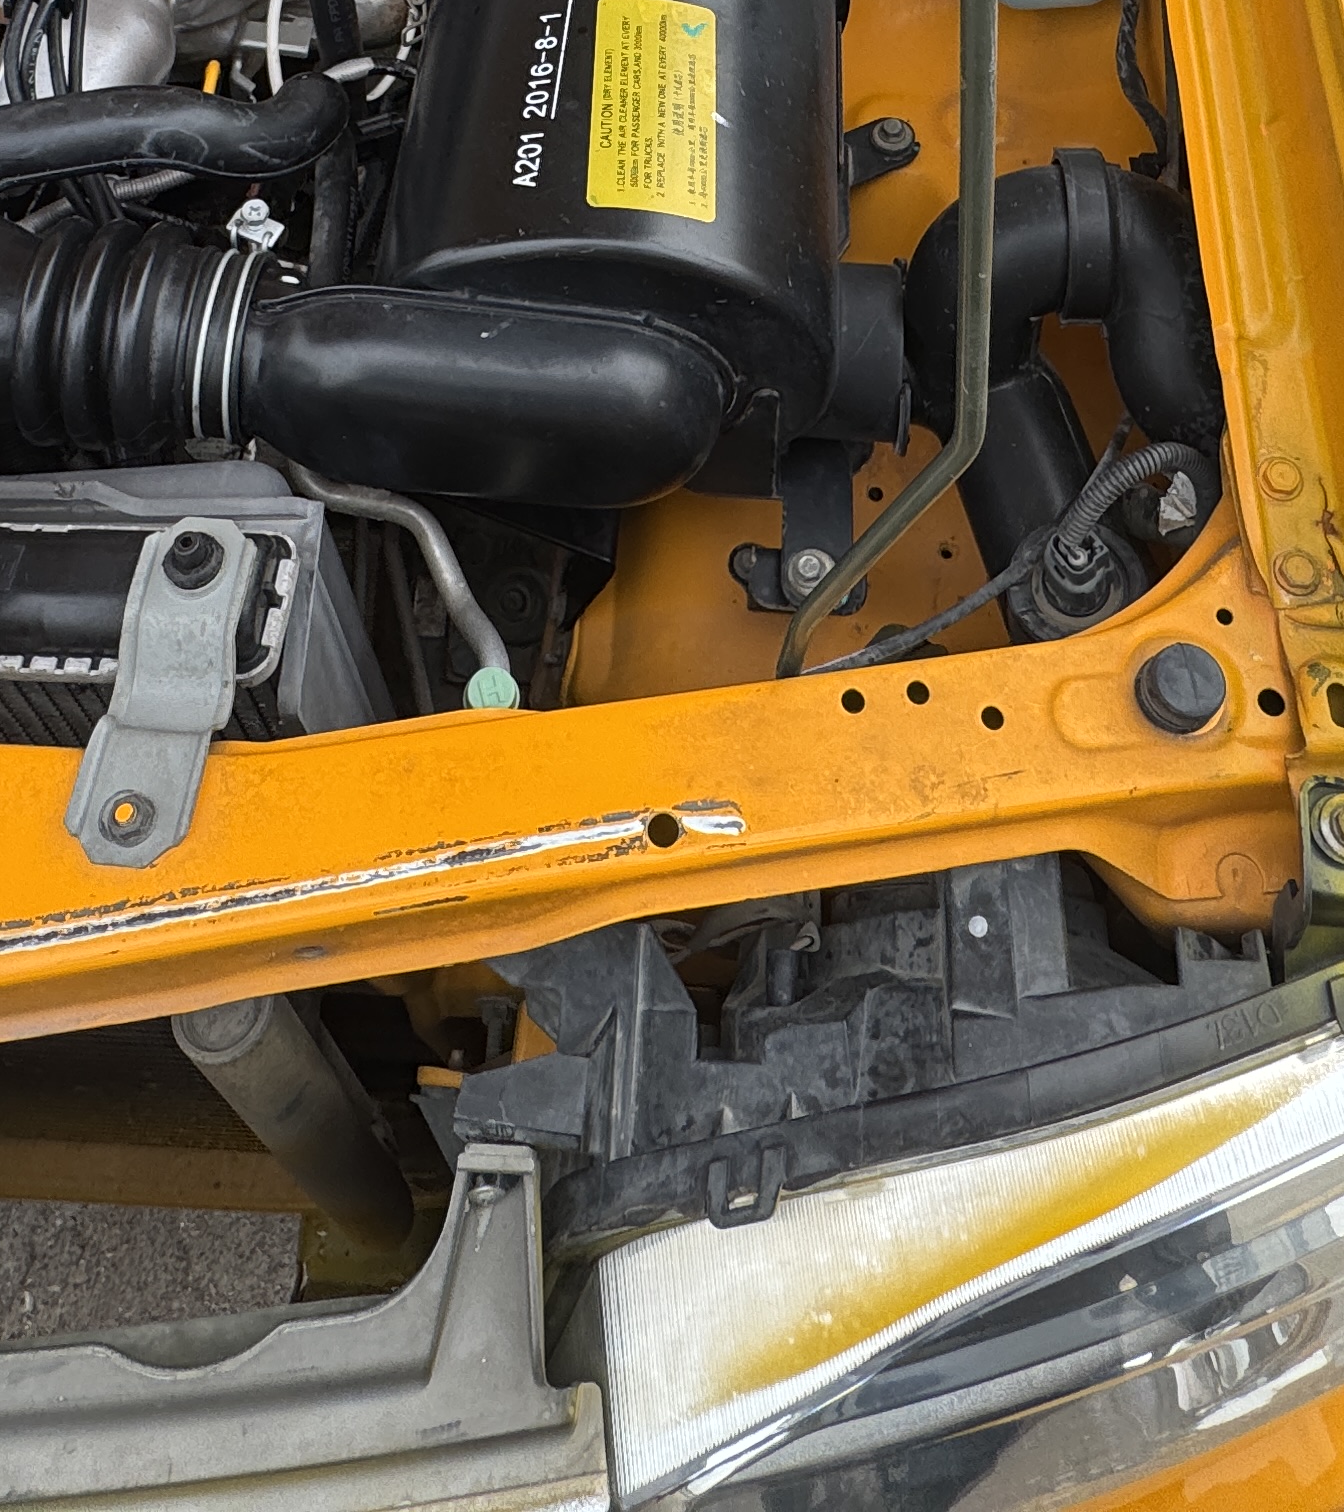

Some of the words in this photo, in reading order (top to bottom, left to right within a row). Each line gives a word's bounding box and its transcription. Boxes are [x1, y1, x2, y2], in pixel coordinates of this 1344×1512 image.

[622, 15, 630, 40] EVERY
[622, 40, 629, 51] AT
[522, 13, 563, 119] 2016-8-1
[658, 45, 667, 69] EVERY
[620, 52, 629, 86] ELEMENT
[658, 70, 667, 80] AT
[658, 83, 667, 99] ONE
[619, 88, 628, 123] CLEANER
[631, 92, 640, 138] PASSENGER
[657, 101, 666, 118] NEW
[600, 103, 613, 148] CAUTION
[619, 125, 627, 138] AIR
[618, 141, 626, 156] THE
[631, 141, 640, 156] FOR
[657, 130, 666, 148] WITH
[512, 132, 545, 188] A201
[656, 152, 666, 188] REPLACE
[643, 173, 653, 189] FOR
